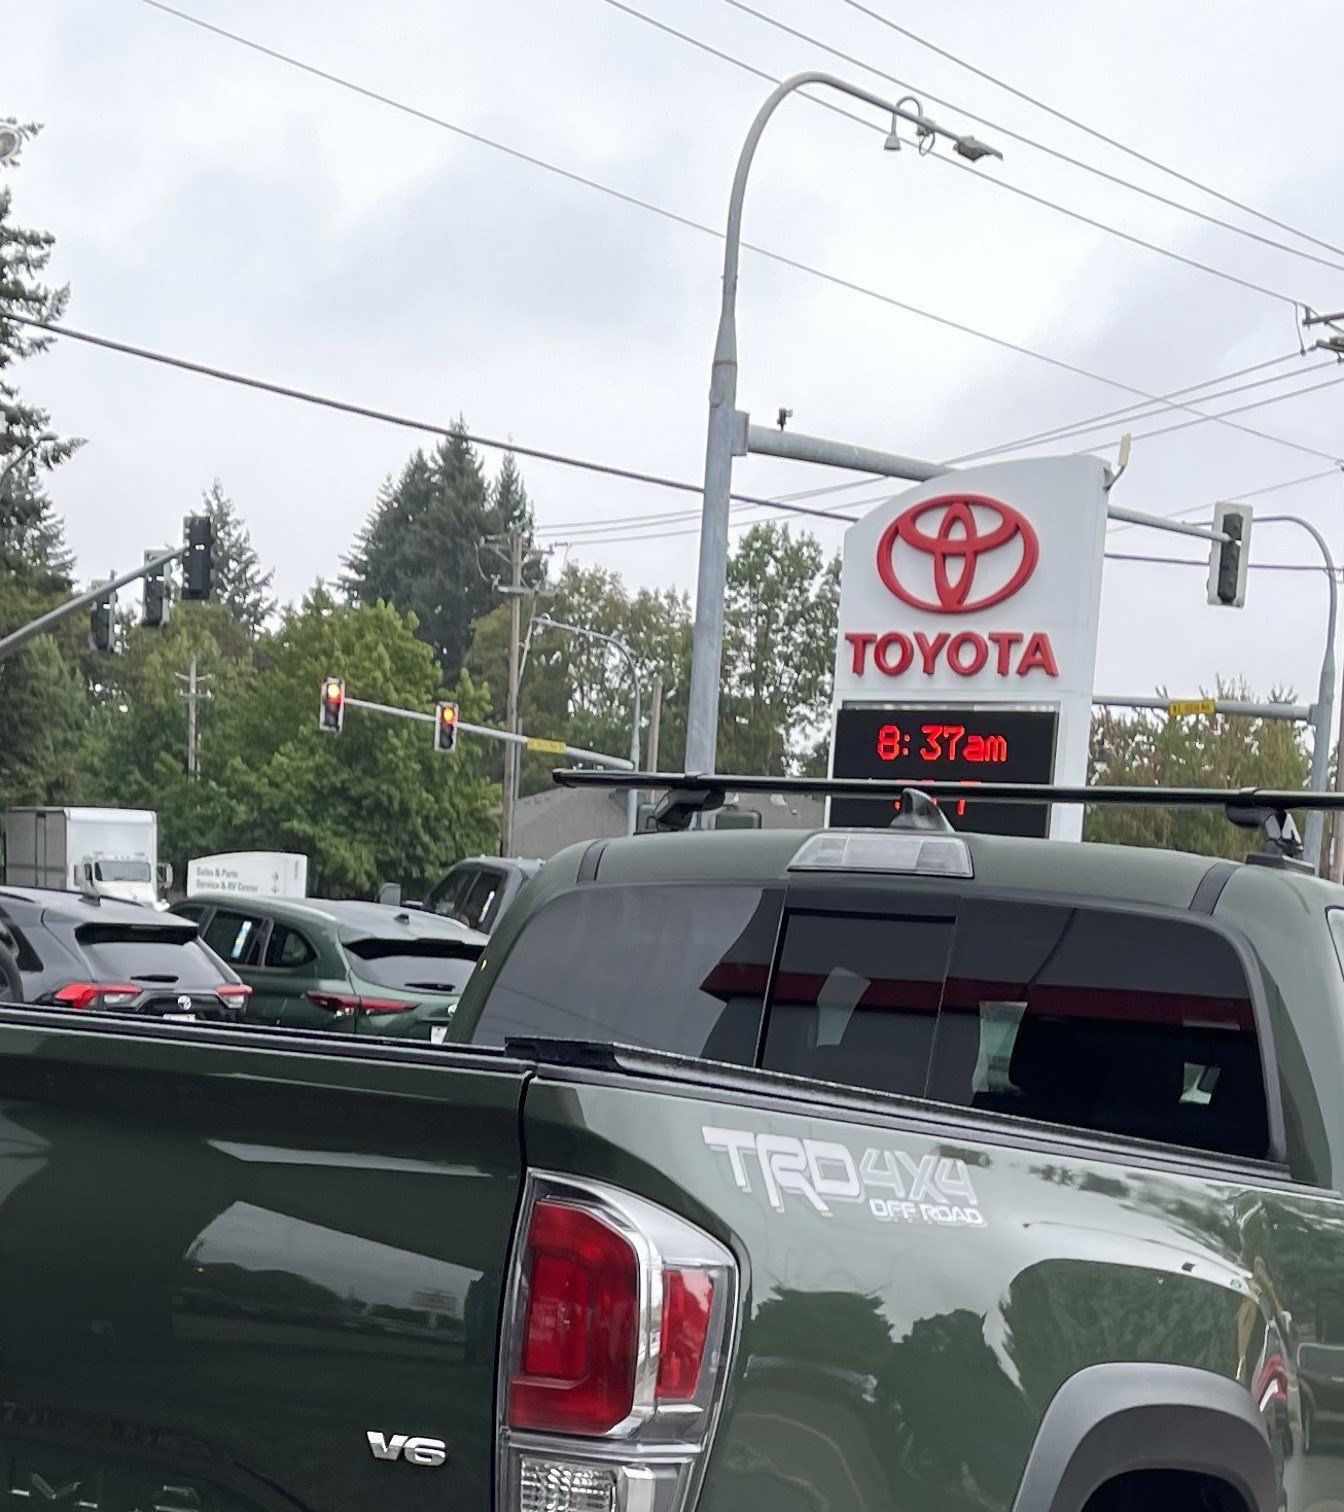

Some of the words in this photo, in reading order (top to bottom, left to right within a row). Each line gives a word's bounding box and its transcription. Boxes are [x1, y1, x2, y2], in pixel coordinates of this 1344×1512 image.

[844, 630, 1060, 678] TOYOTA
[877, 724, 1008, 763] 8:37am
[701, 1126, 865, 1218] TRD
[869, 1198, 919, 1223] OFF
[920, 1201, 988, 1228] ROAD
[366, 1431, 446, 1467] V6
